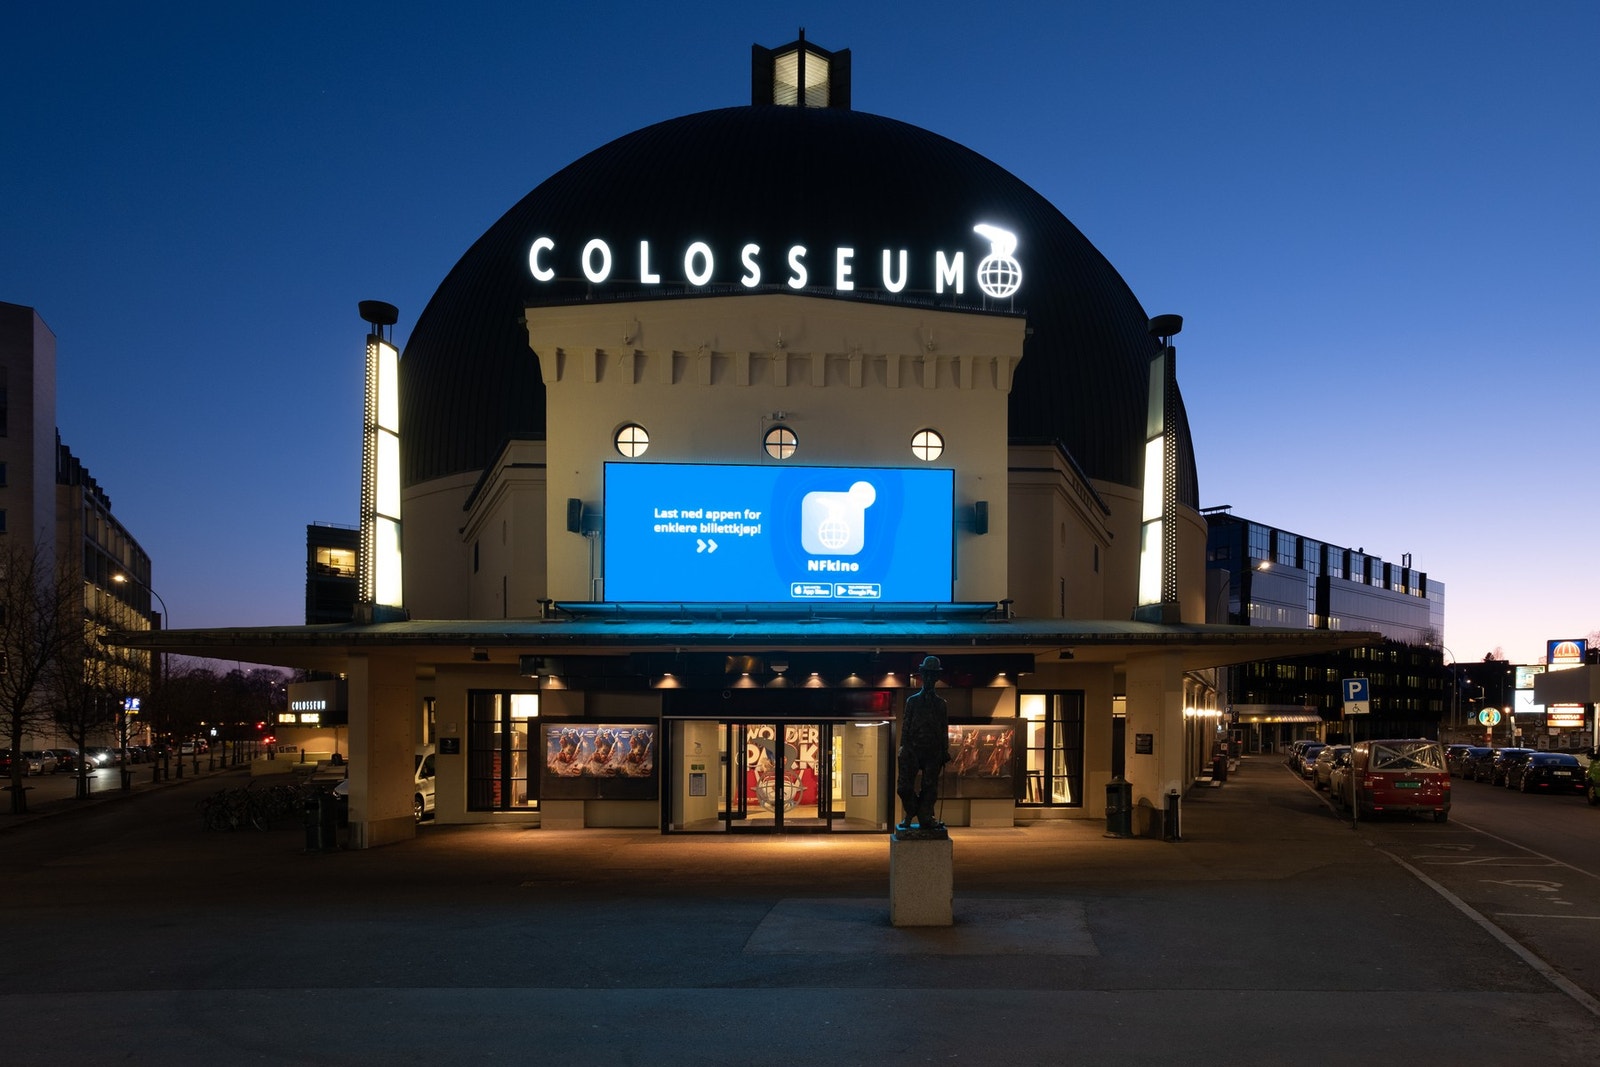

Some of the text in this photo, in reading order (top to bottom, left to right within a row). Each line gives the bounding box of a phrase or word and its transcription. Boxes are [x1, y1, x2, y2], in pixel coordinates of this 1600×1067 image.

[528, 236, 965, 295] COLOSSEUM
[654, 508, 761, 522] Last ned appen for
[653, 522, 761, 537] enklere billettkjøp!
[807, 559, 859, 572] NFkino
[1349, 681, 1362, 699] P
[291, 700, 326, 711] COLOSSEUM
